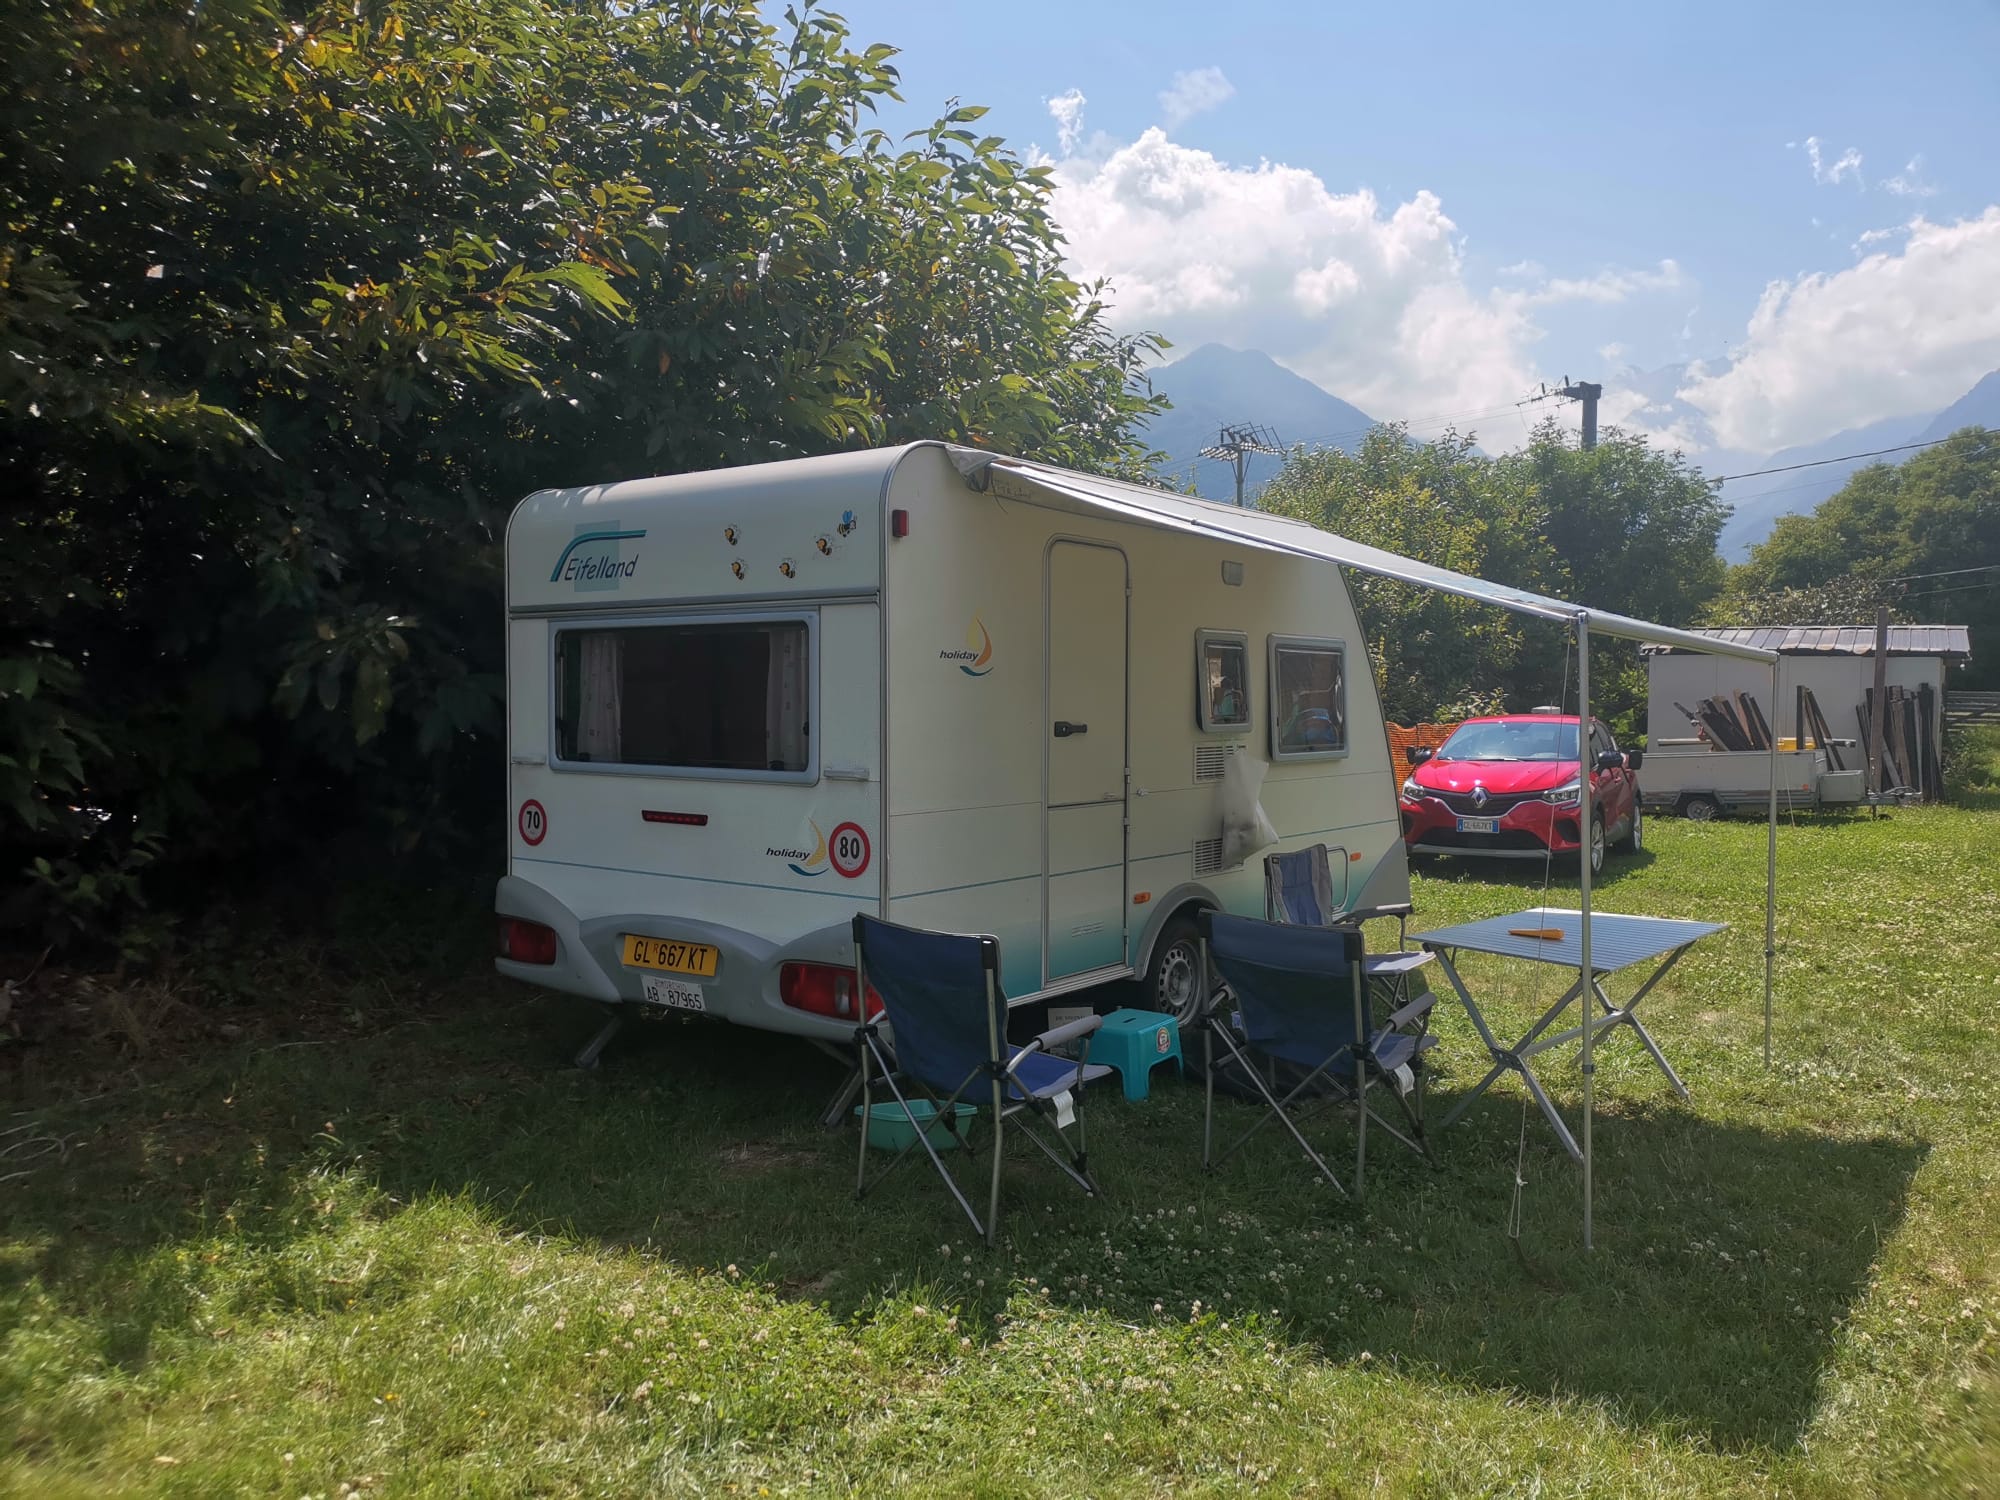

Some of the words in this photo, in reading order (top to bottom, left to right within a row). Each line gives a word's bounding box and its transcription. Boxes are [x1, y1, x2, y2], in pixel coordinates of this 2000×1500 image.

[564, 553, 639, 581] Eifelland
[939, 649, 979, 662] holiday
[526, 810, 541, 829] 70
[766, 847, 811, 862] holiday
[839, 836, 860, 859] 80
[633, 940, 650, 964] GL
[658, 943, 686, 968] 667
[687, 947, 708, 971] KT
[647, 986, 660, 1002] AB
[668, 990, 702, 1009] 87965
